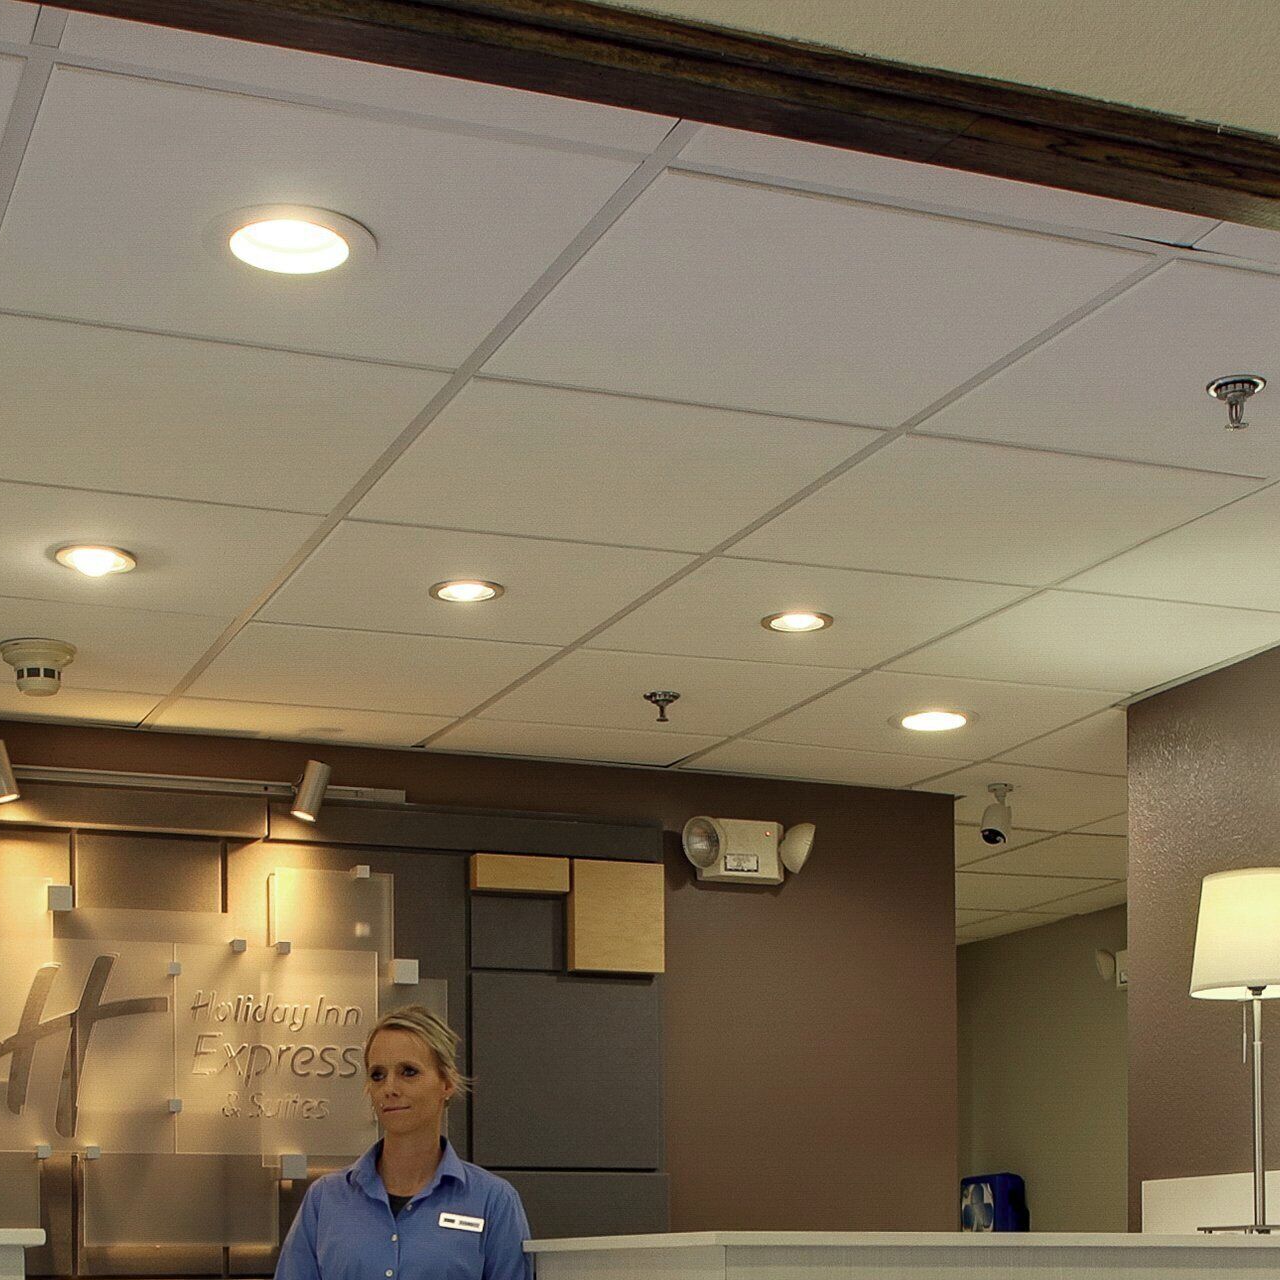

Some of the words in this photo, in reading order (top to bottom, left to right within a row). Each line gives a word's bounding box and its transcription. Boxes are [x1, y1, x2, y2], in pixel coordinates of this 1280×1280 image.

[190, 989, 310, 1033] Holiday
[316, 994, 363, 1026] Inn
[192, 1031, 363, 1088] Express
[222, 1091, 241, 1119] &
[249, 1092, 331, 1119] Suites
